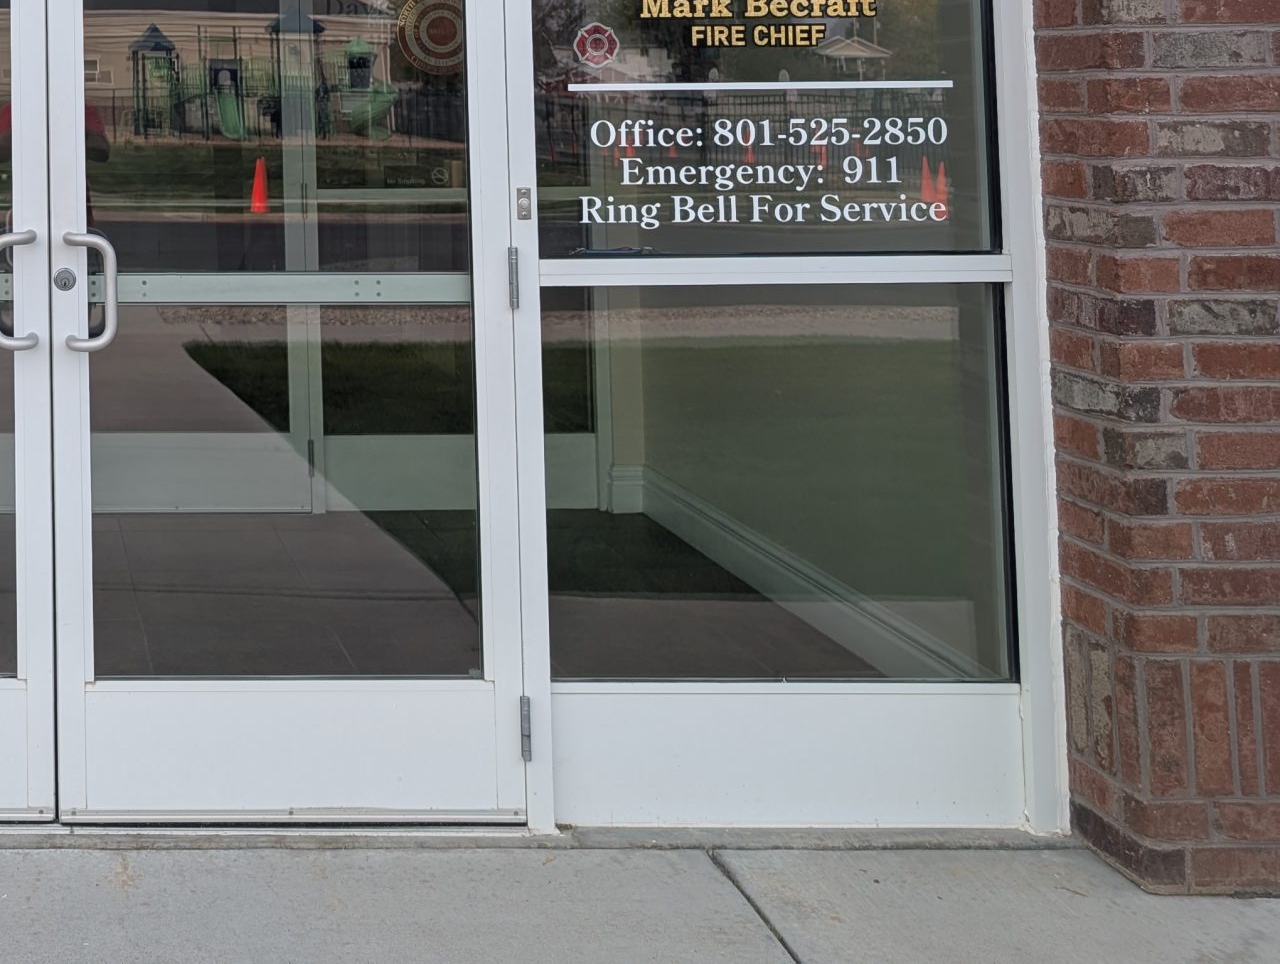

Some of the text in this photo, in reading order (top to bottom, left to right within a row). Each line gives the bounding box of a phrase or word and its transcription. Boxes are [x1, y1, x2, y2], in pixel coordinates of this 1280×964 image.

[691, 25, 826, 47] FIRE CHIEF
[590, 117, 948, 148] Office: 801-525-2850
[620, 155, 902, 192] Emergency: 911
[579, 193, 948, 230] Ring Bell For Service
